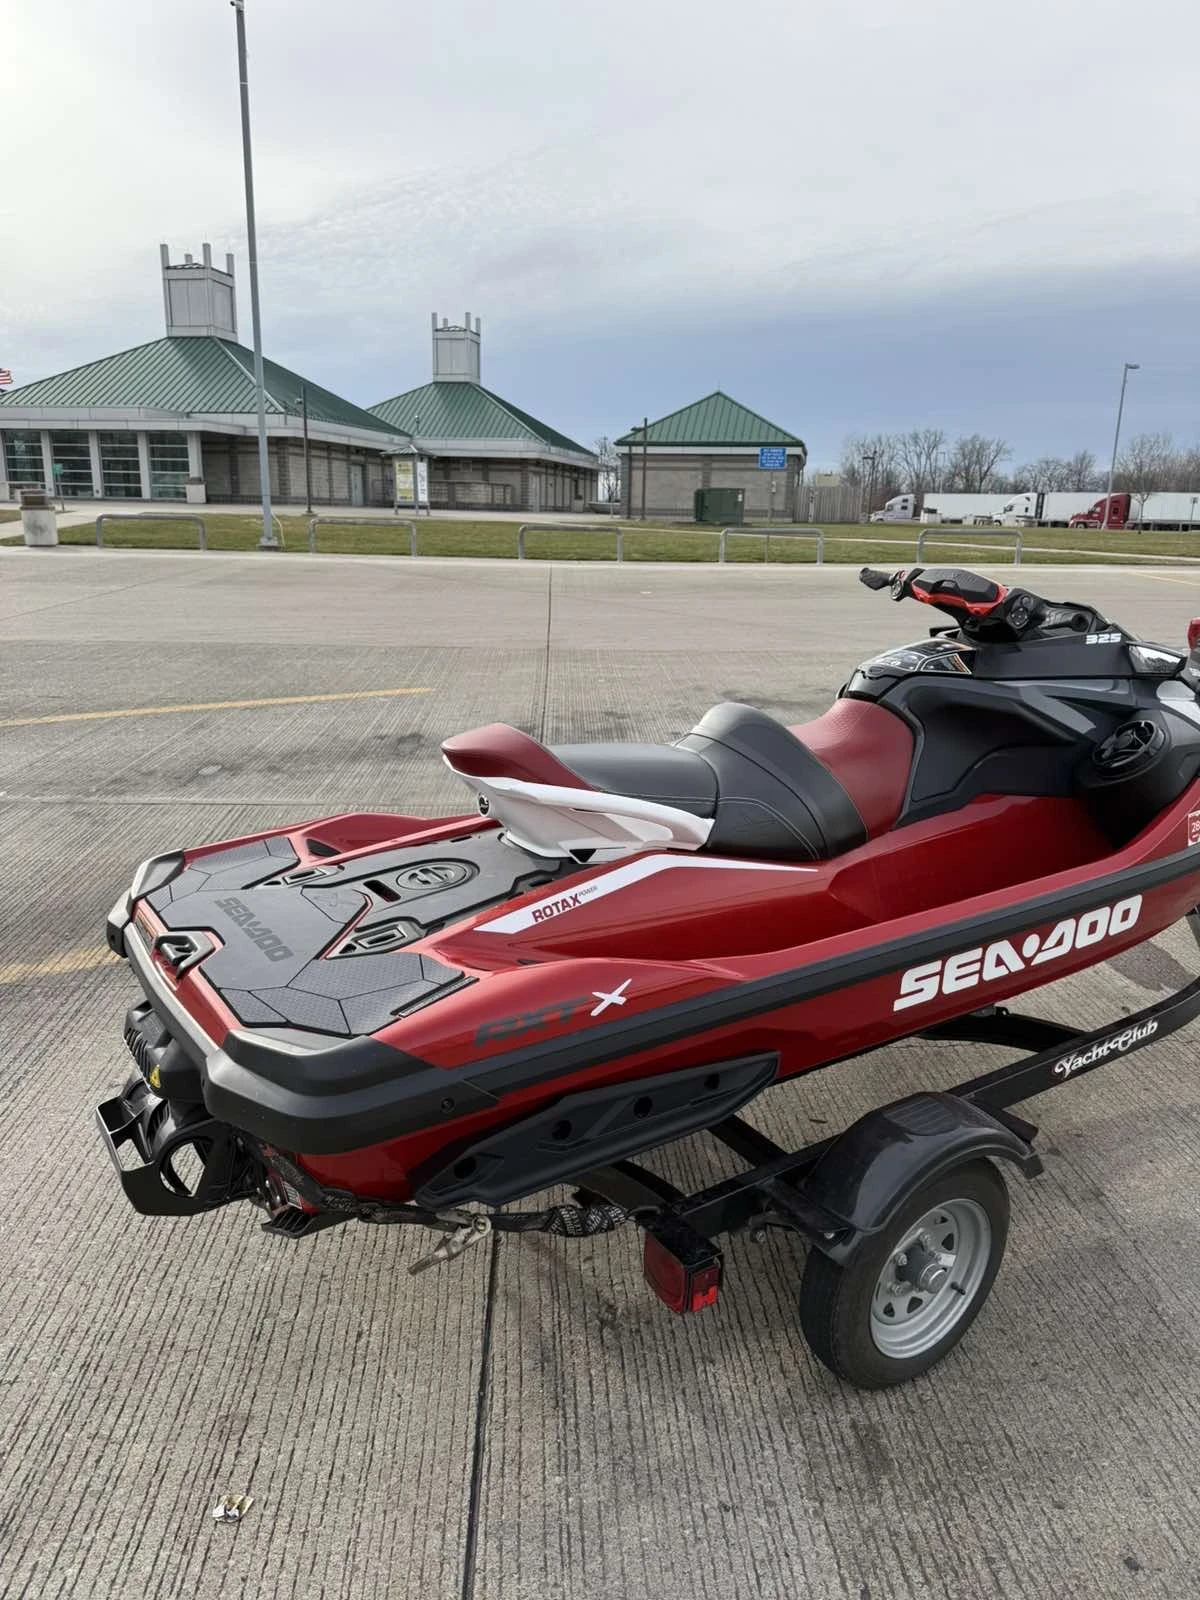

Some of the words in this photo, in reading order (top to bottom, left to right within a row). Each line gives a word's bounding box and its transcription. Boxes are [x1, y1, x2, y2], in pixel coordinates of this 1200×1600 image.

[1086, 632, 1121, 645] 325
[531, 892, 582, 923] ROTAX
[473, 995, 592, 1047] RXT
[590, 978, 633, 1017] X
